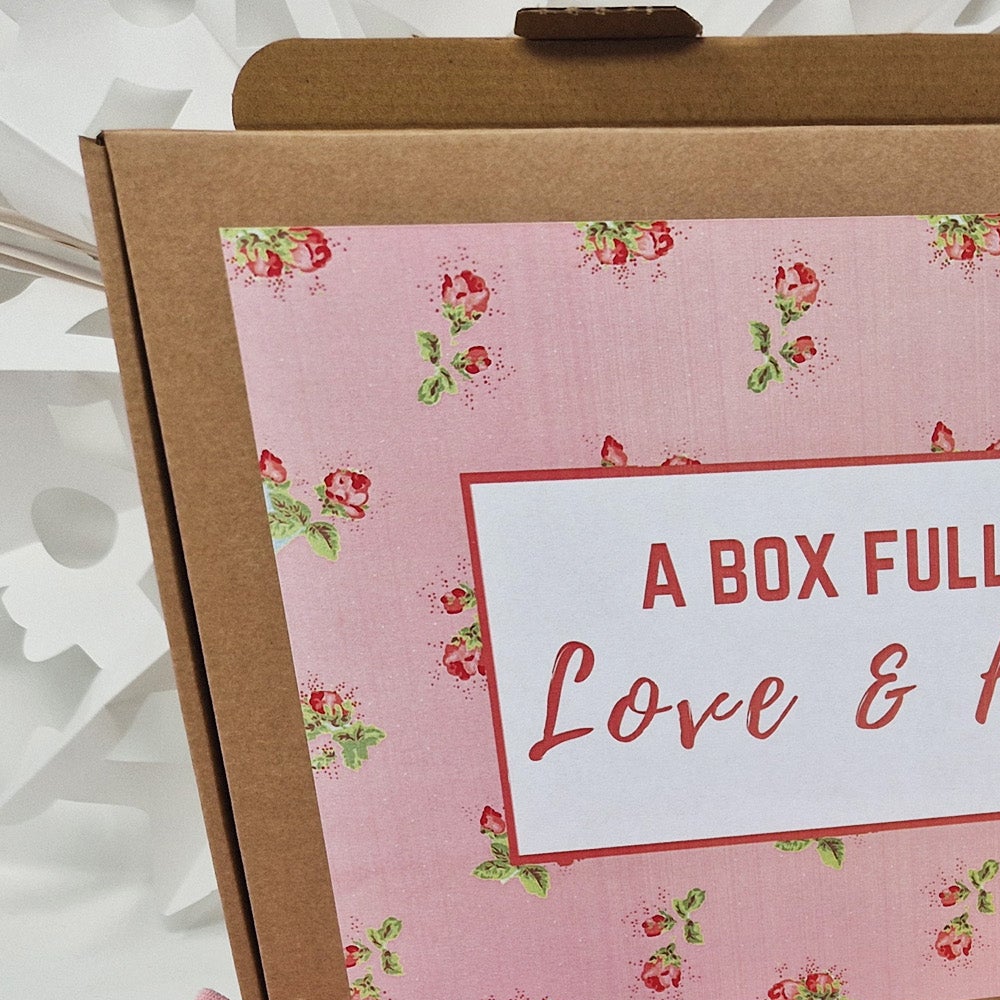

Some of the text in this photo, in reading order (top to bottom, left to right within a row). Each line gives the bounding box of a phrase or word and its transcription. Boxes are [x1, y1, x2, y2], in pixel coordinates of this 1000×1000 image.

[642, 543, 686, 609] A
[710, 534, 839, 605] BOX
[528, 641, 800, 762] Love
[855, 643, 916, 730] &
